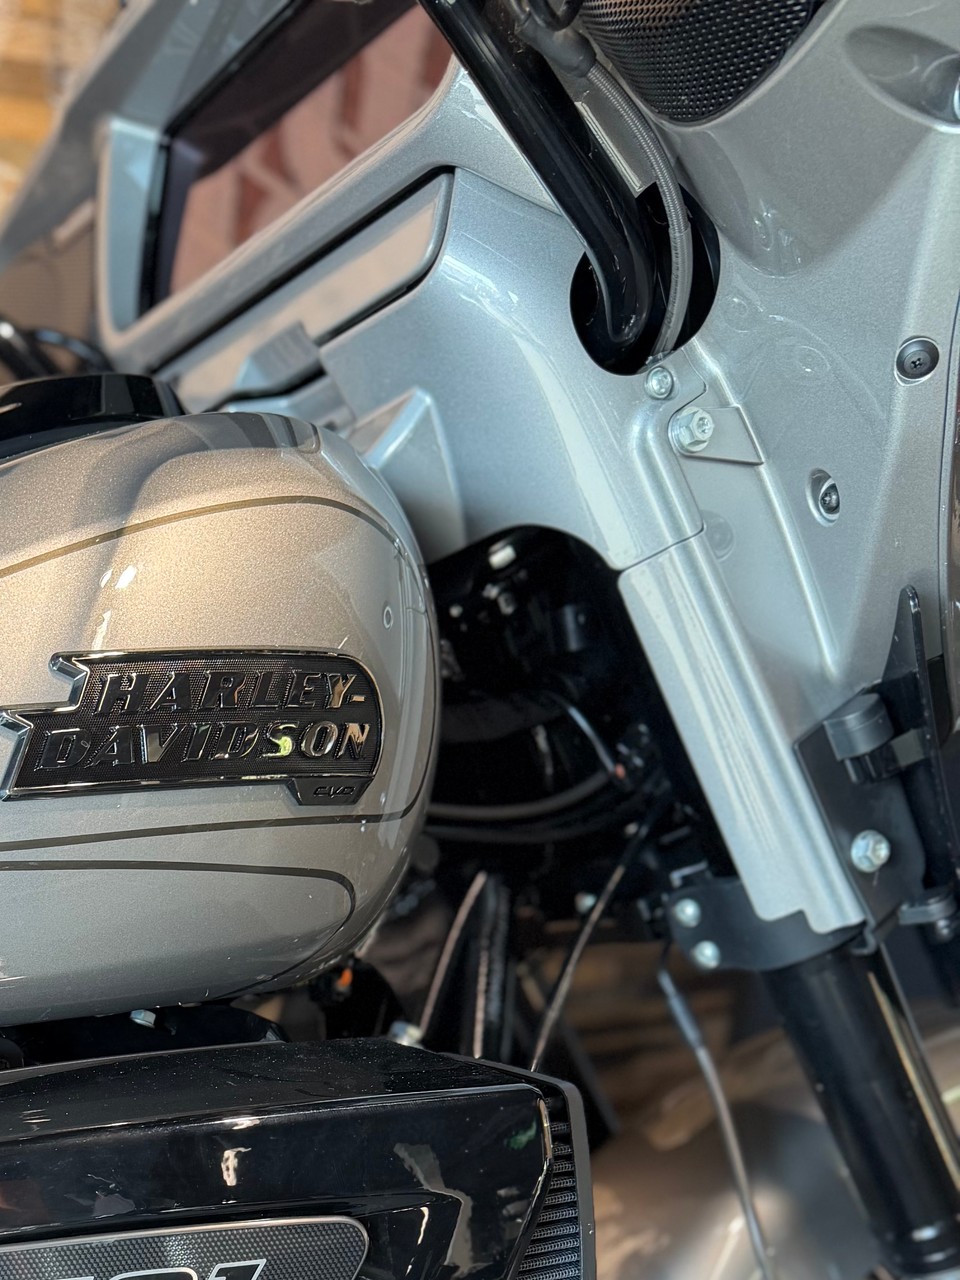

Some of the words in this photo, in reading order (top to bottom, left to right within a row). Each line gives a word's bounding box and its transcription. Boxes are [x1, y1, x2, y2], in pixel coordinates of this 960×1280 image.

[92, 669, 366, 716] HARLEY-
[33, 719, 371, 771] DAVIDSON
[312, 785, 357, 799] CVO
